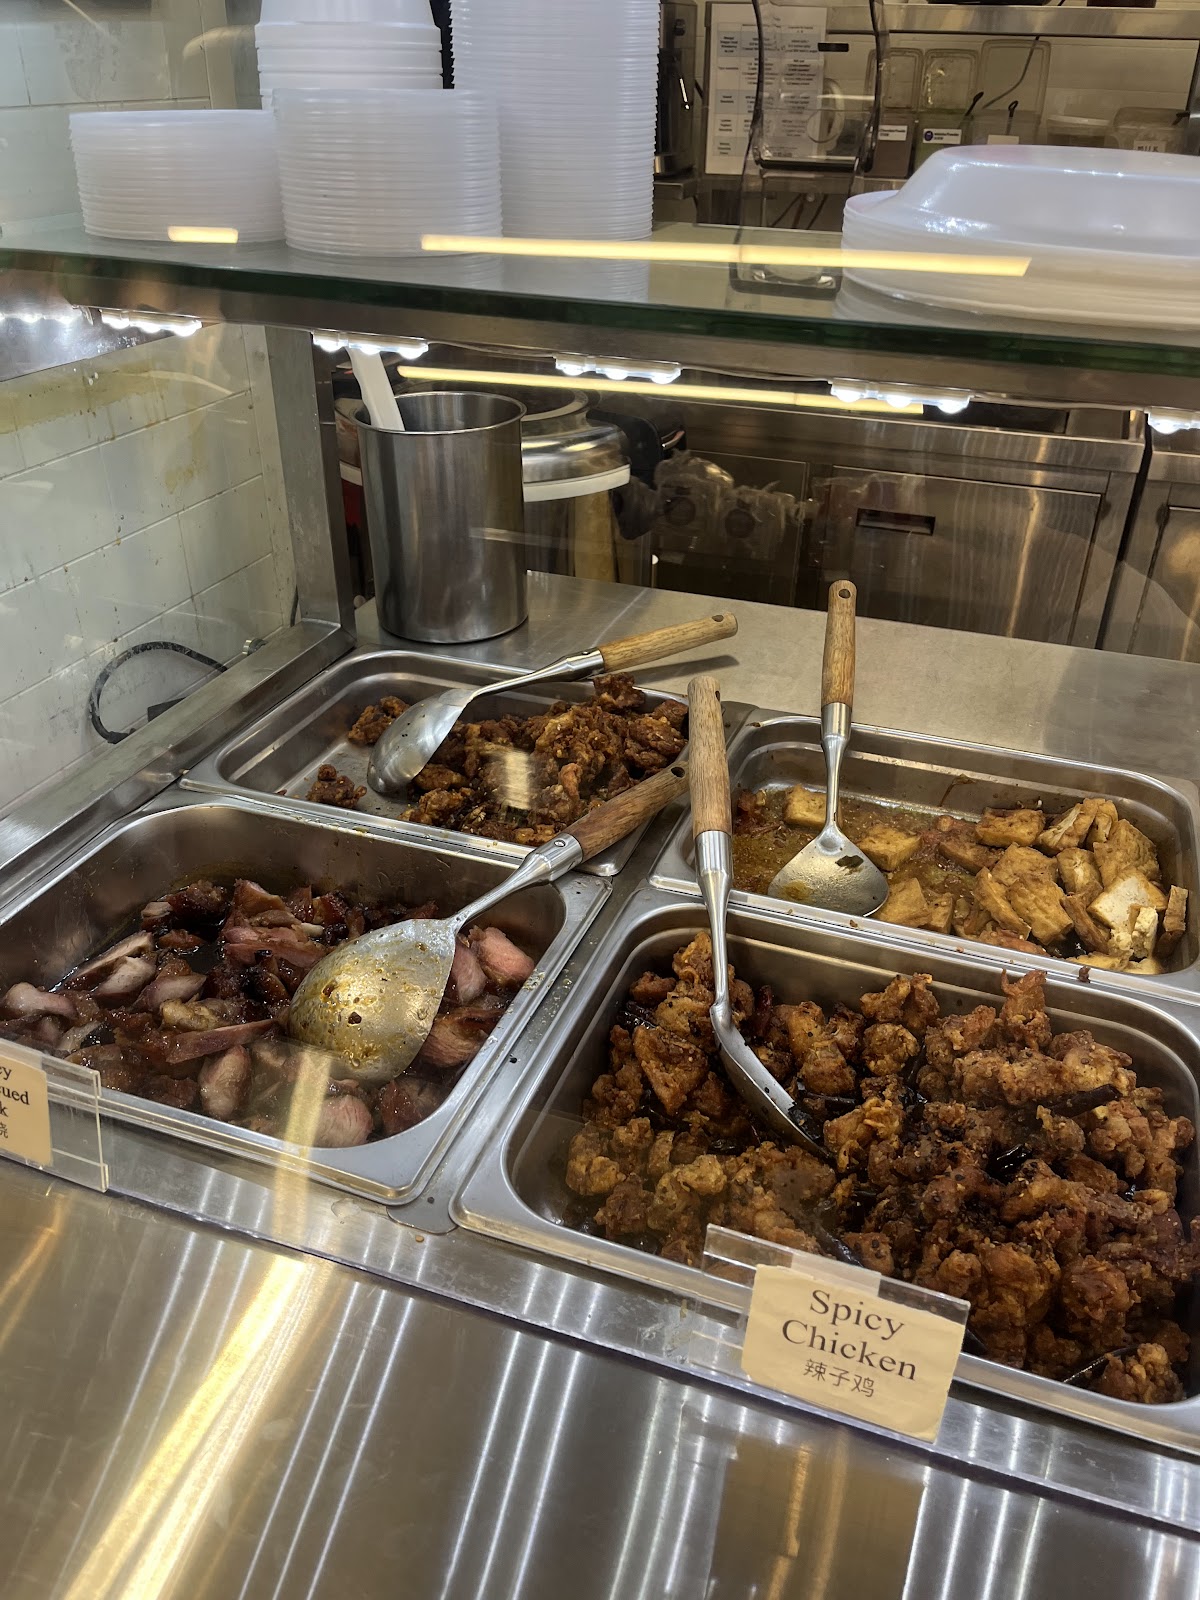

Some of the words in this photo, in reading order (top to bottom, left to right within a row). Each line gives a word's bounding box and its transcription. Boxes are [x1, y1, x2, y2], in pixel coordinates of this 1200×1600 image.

[0, 1086, 30, 1105] ued
[810, 1289, 905, 1340] Spicy
[782, 1319, 917, 1381] Chicken
[803, 1358, 875, 1398] 辣子鸡
